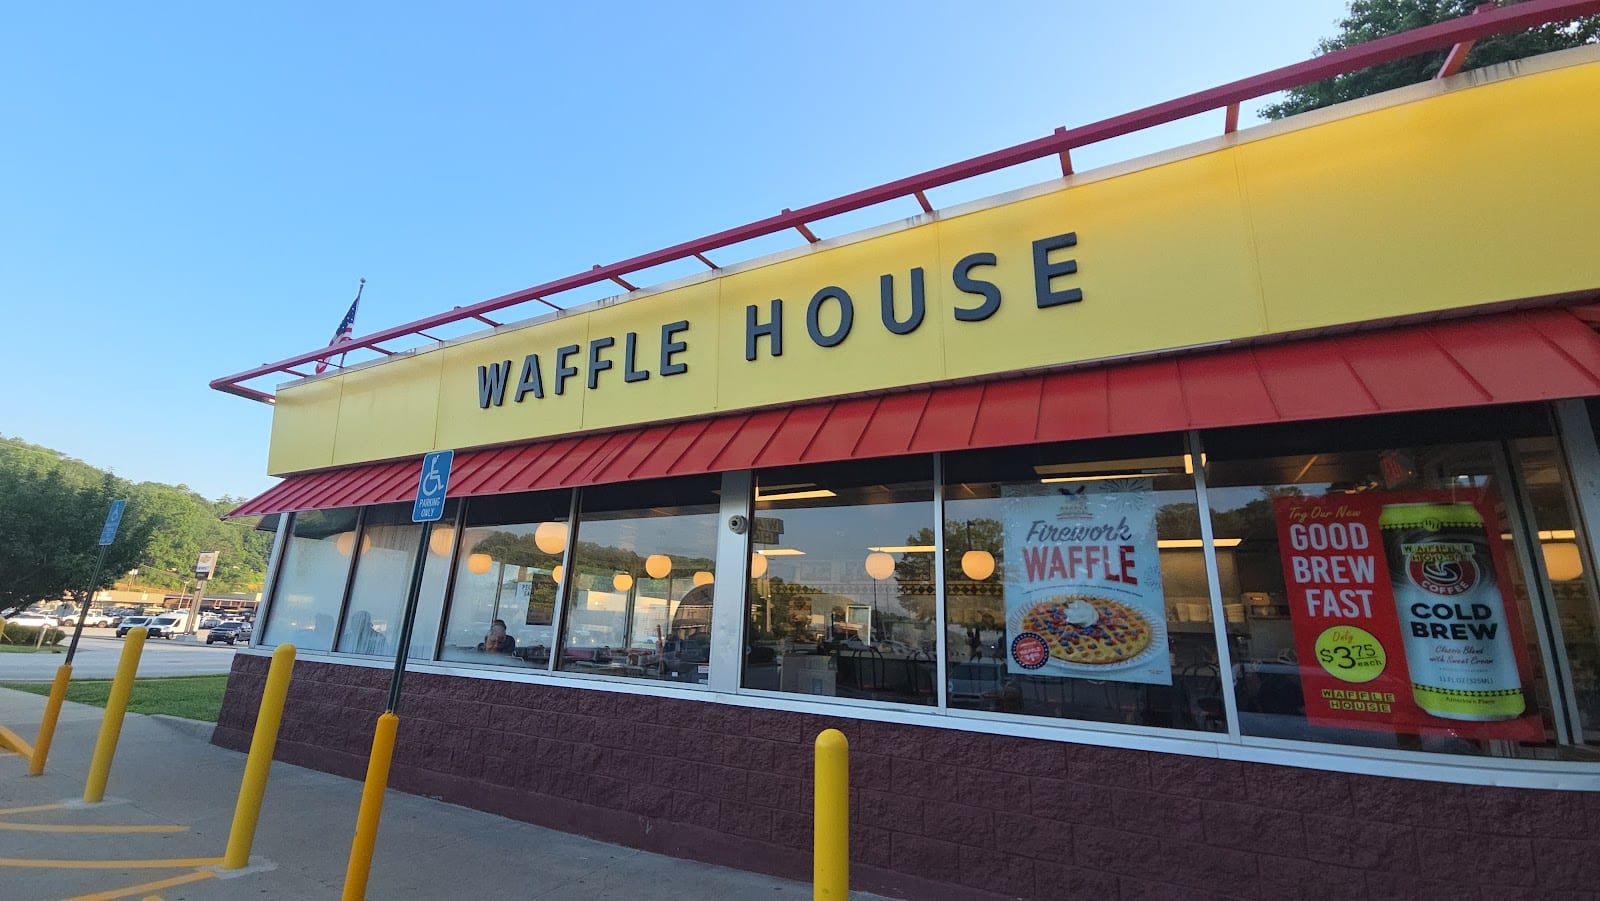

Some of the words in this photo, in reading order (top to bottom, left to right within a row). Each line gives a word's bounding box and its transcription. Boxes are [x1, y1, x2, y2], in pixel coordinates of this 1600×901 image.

[477, 320, 690, 409] WAFFLE
[746, 231, 1083, 361] HOUSE
[419, 497, 441, 509] PARKING
[420, 508, 435, 518] ONLY
[1289, 506, 1308, 523] Try
[1310, 506, 1333, 519] Our
[1335, 505, 1361, 518] New
[1026, 516, 1132, 543] Firework
[1290, 522, 1369, 551] GOOD
[1023, 545, 1138, 585] WAFFLE
[1292, 555, 1375, 584] BREW
[1422, 580, 1470, 595] COFFEE
[1305, 588, 1373, 618] FAST
[1410, 602, 1492, 620] COLD
[1332, 630, 1354, 644] Only
[1410, 621, 1498, 640] BREW
[1357, 659, 1383, 667] each
[1322, 689, 1395, 702] WAFFLE
[1330, 700, 1391, 713] HOUSE
